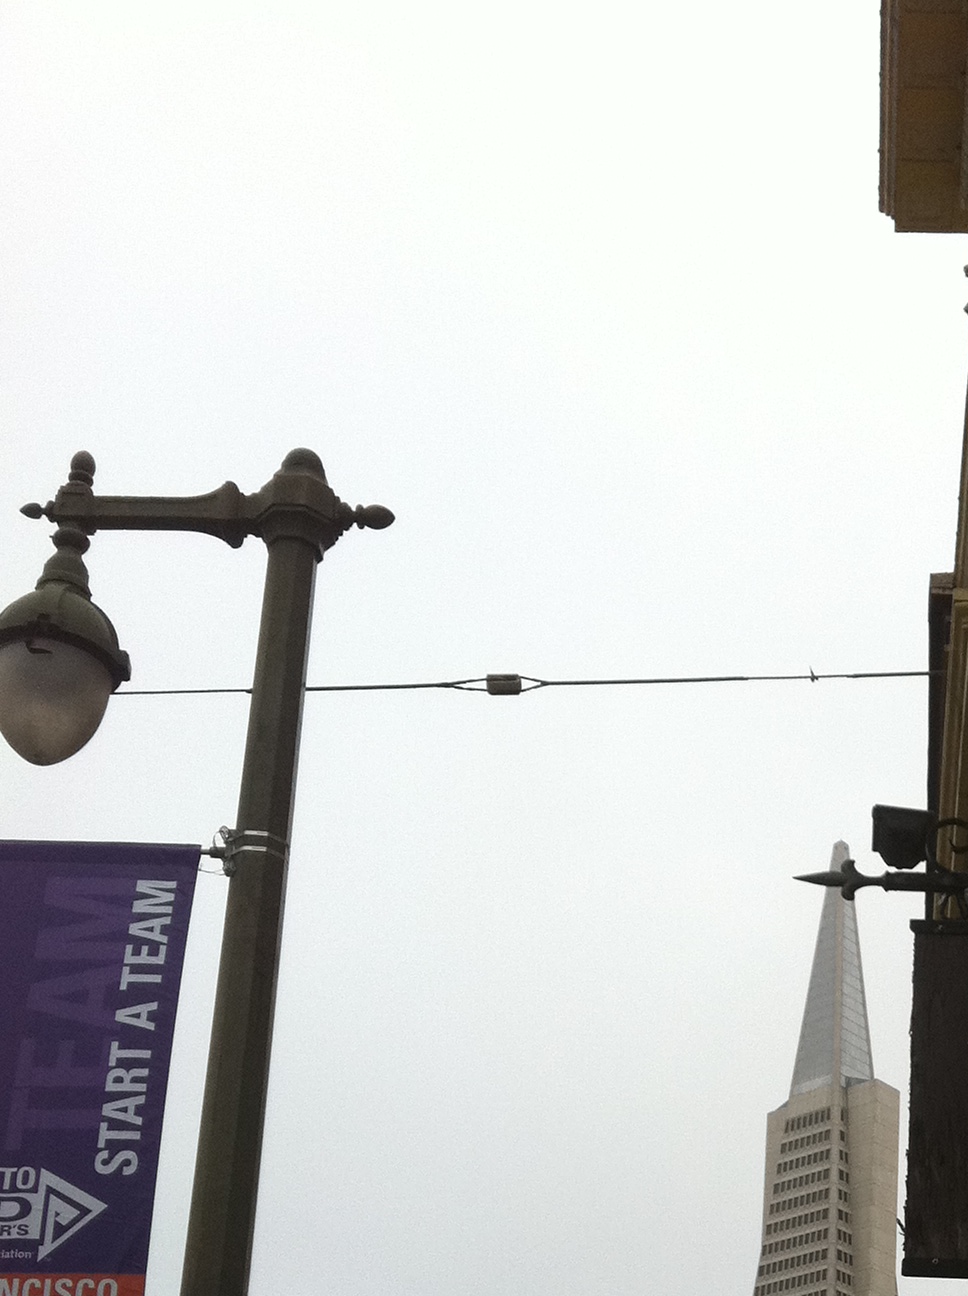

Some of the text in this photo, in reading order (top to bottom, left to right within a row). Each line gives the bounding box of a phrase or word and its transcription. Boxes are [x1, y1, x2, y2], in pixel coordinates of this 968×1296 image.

[94, 879, 177, 1176] START A TEAM
